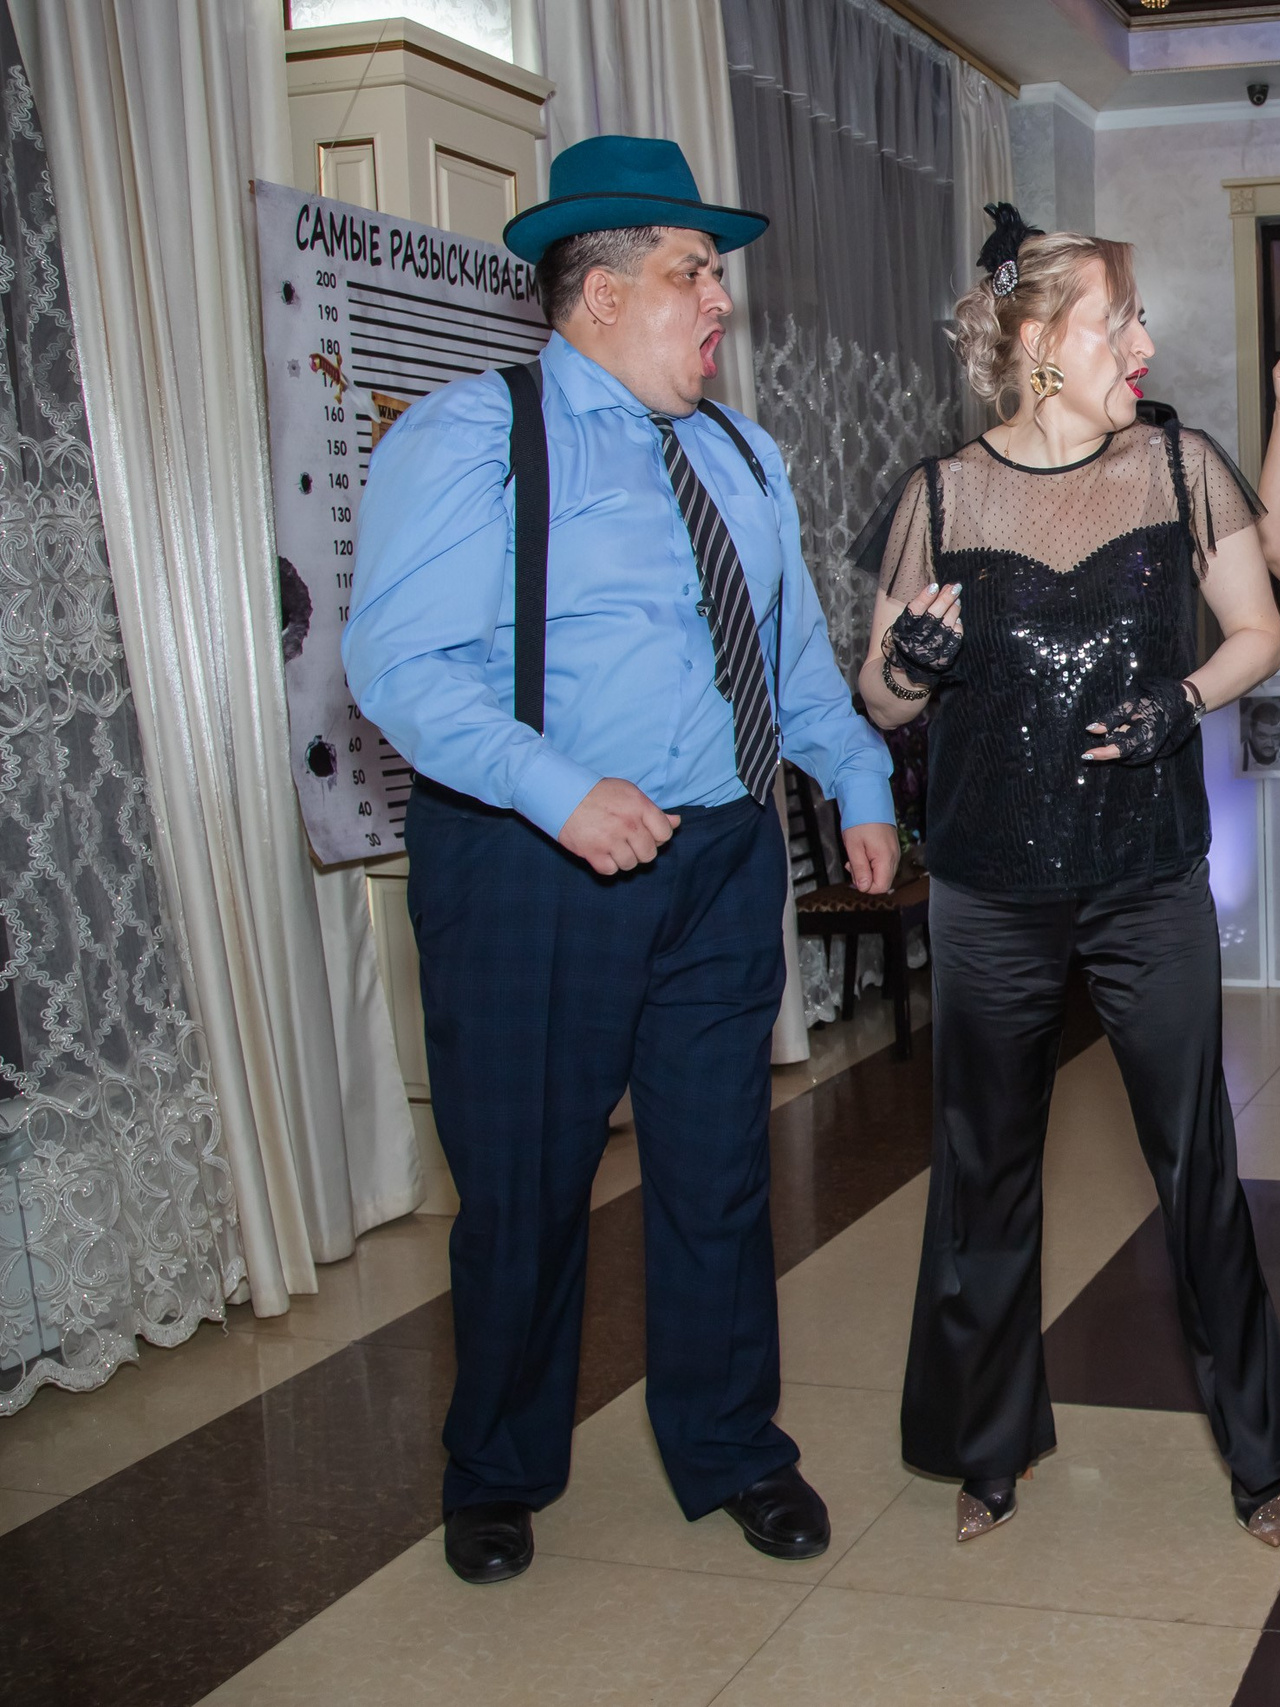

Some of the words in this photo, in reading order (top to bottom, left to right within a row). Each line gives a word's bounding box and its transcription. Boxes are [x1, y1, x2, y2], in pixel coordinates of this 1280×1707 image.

[296, 204, 381, 267] САМЫЕ
[316, 270, 337, 289] 200
[318, 304, 338, 322] 190
[320, 338, 340, 355] 180
[324, 405, 344, 423] 160
[327, 439, 347, 456] 150
[329, 473, 349, 489] 140
[331, 506, 351, 522] 130
[334, 540, 353, 556] 120
[347, 704, 361, 720] 70
[348, 736, 362, 753] 60
[352, 769, 366, 785] 50
[358, 801, 372, 816] 40
[365, 833, 382, 847] 30
